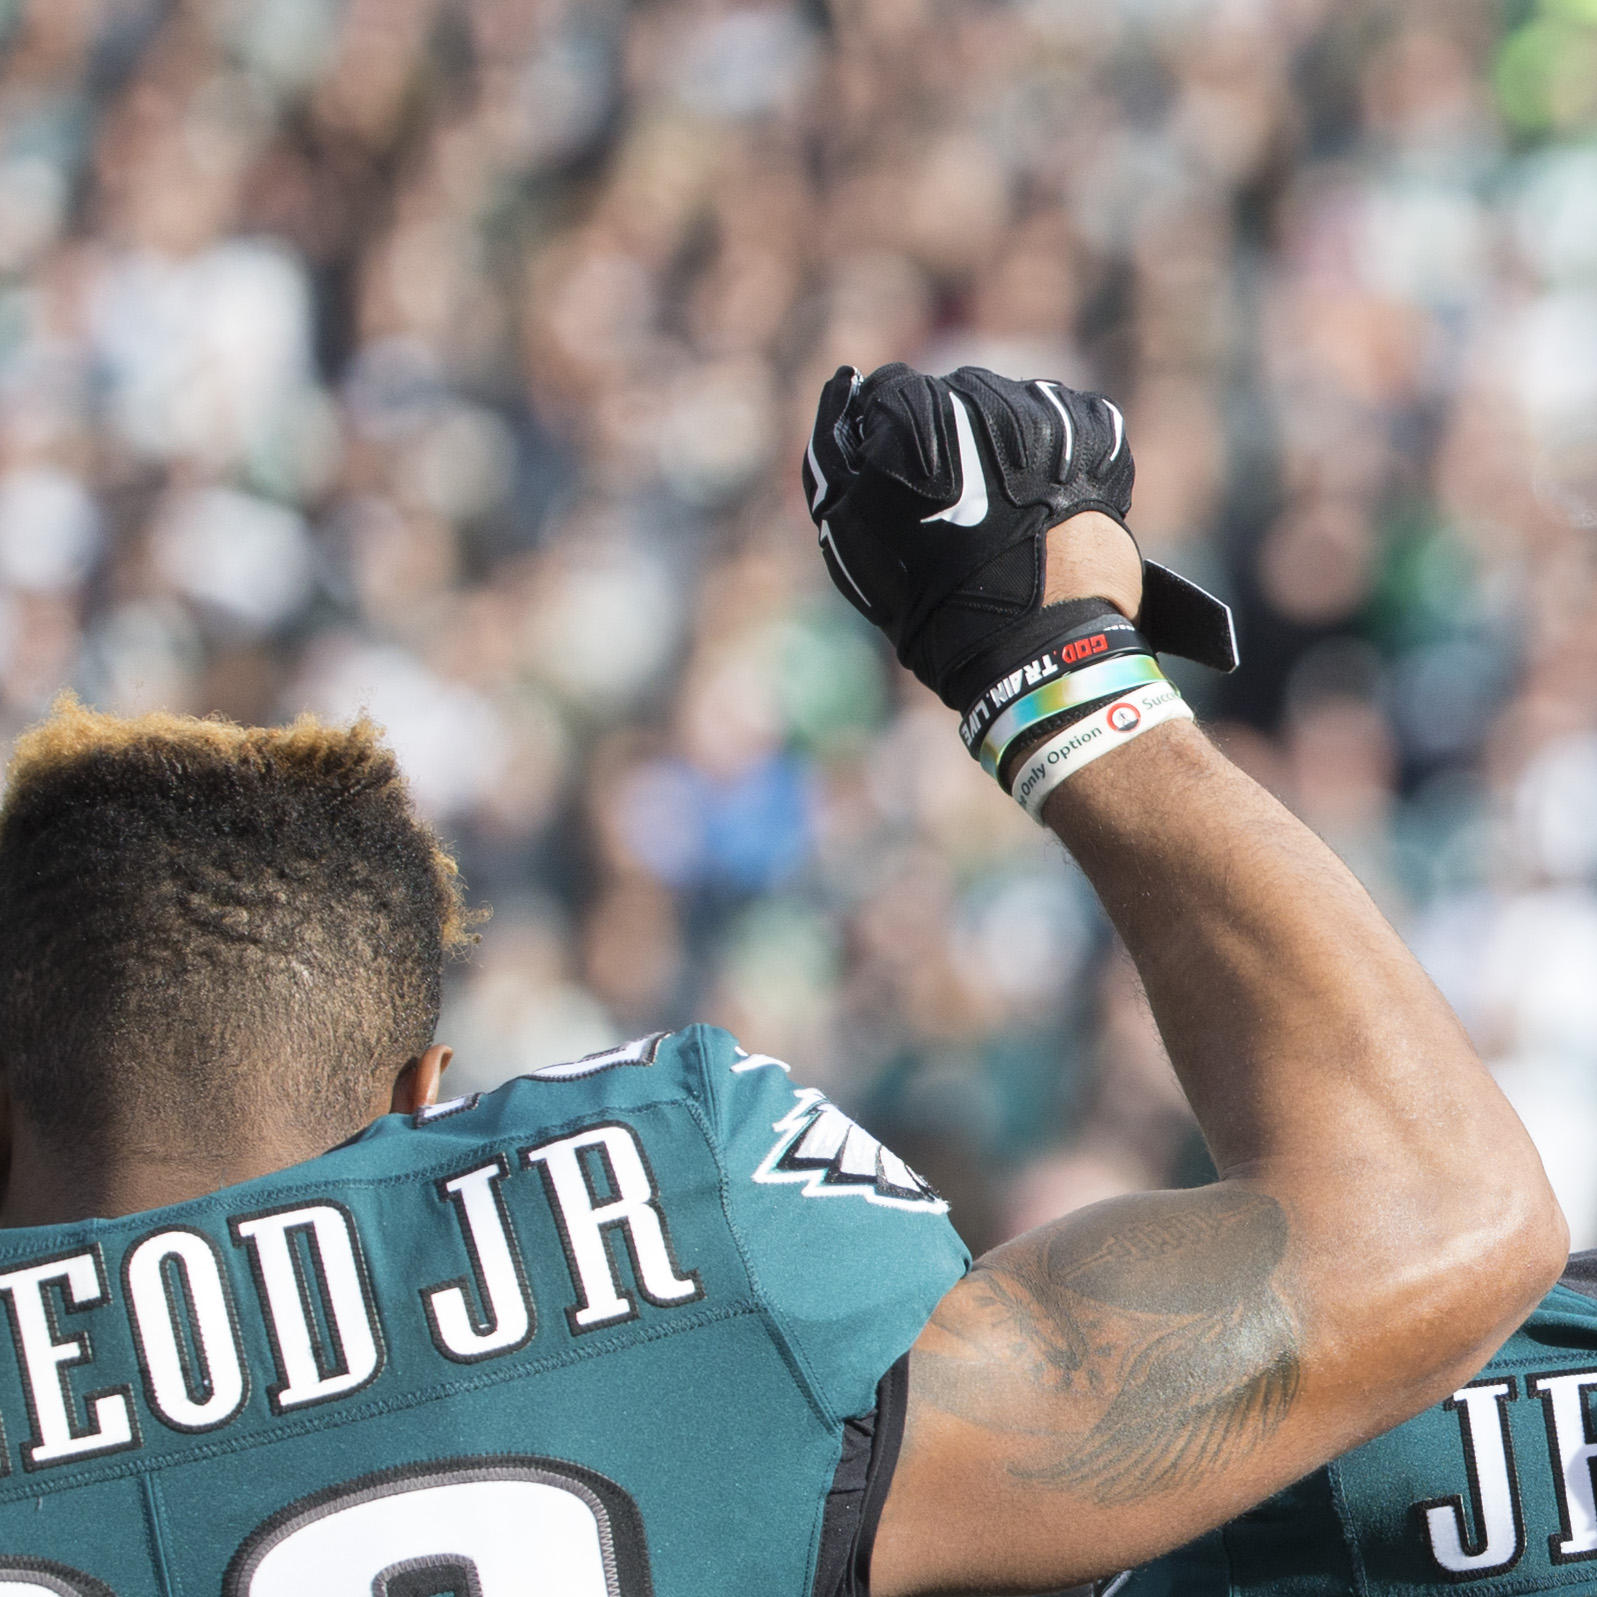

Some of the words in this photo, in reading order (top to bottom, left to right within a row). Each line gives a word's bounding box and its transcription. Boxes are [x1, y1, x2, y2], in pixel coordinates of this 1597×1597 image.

[1021, 763, 1046, 796] Only
[1047, 727, 1103, 766] Option
[0, 1199, 388, 1478] EOD
[418, 1120, 706, 1366] JR
